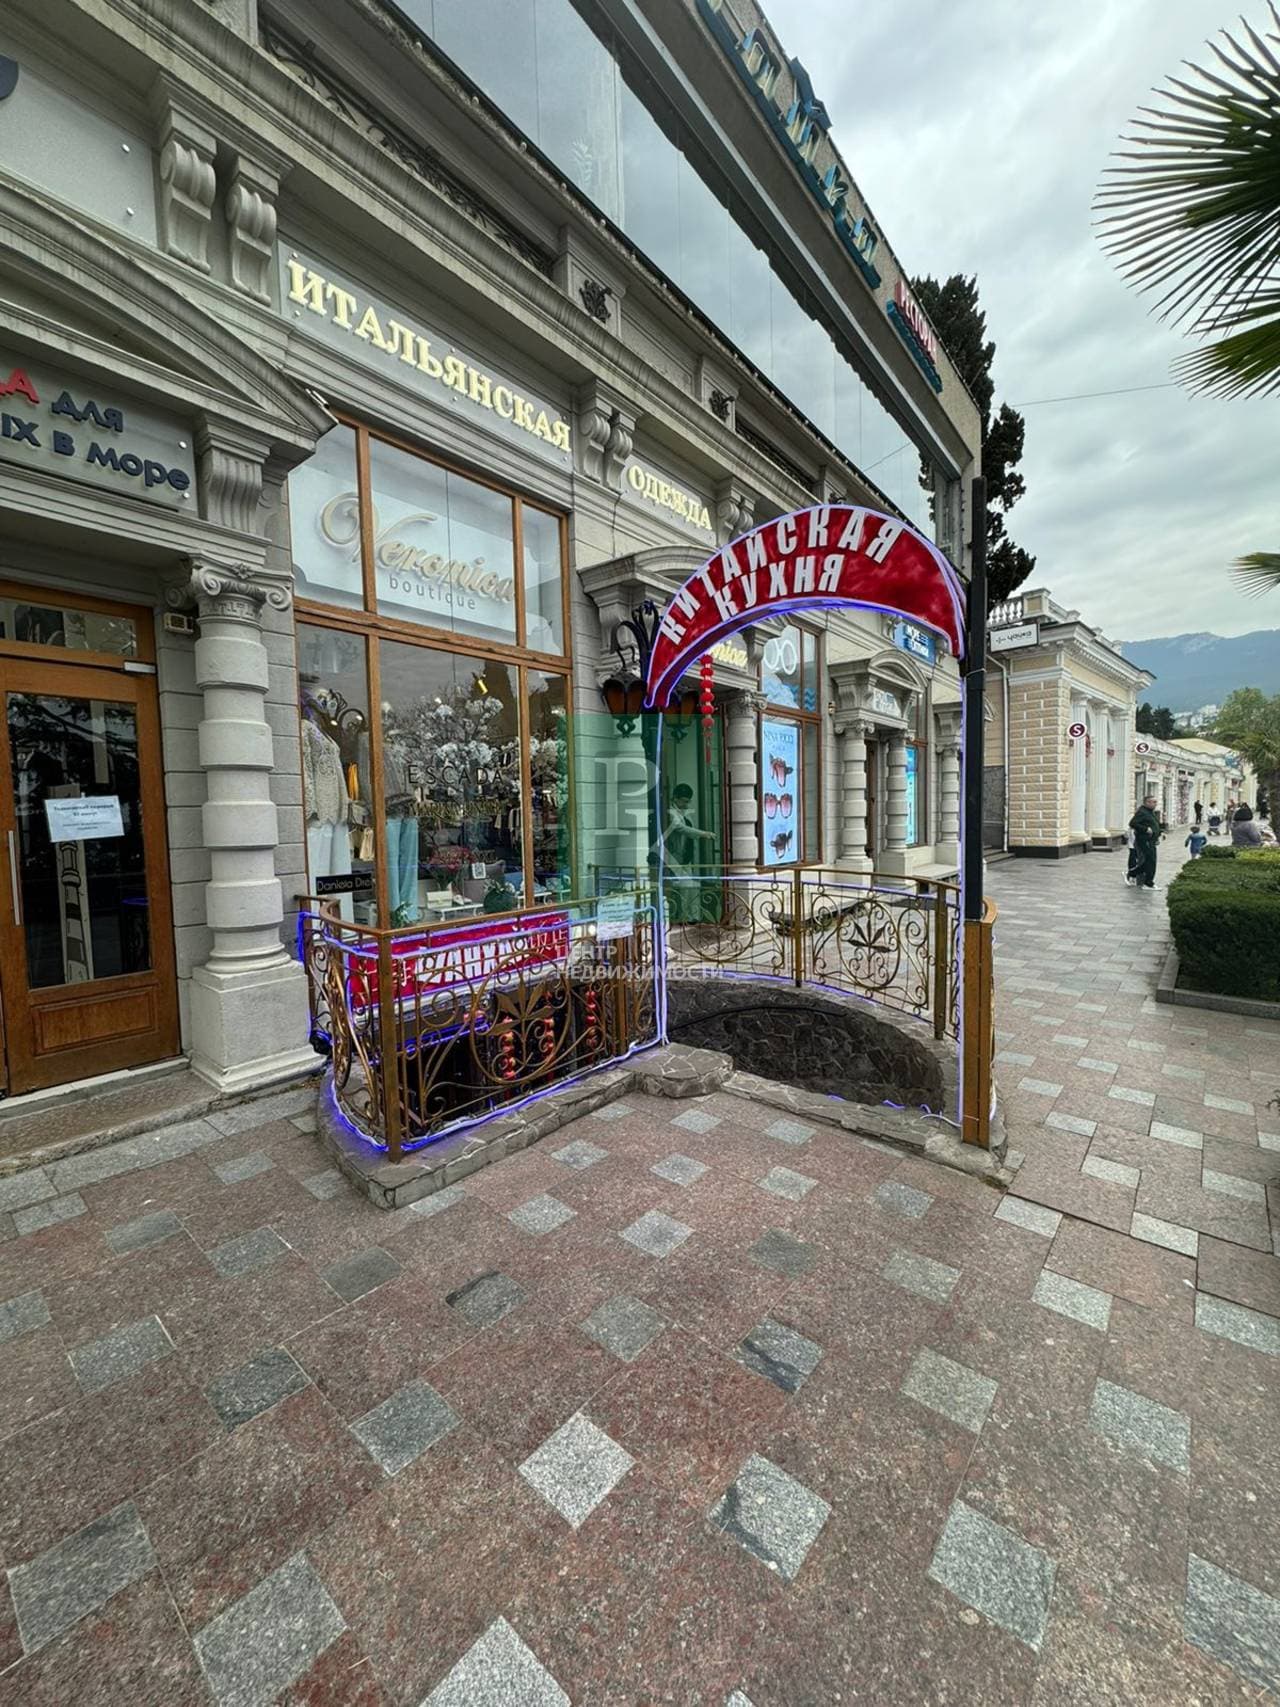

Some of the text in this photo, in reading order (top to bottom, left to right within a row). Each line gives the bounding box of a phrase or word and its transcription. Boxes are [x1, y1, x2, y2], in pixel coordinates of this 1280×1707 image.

[288, 258, 571, 453] ИТАЛЬЯНСКАЯ
[628, 464, 713, 530] ОДЕЖДА
[320, 491, 516, 603] Veronica
[659, 507, 905, 645] КИТАЙСКАЯ
[388, 575, 477, 610] boutique
[712, 554, 845, 622] КУХНЯ
[408, 763, 502, 785] ESCADA
